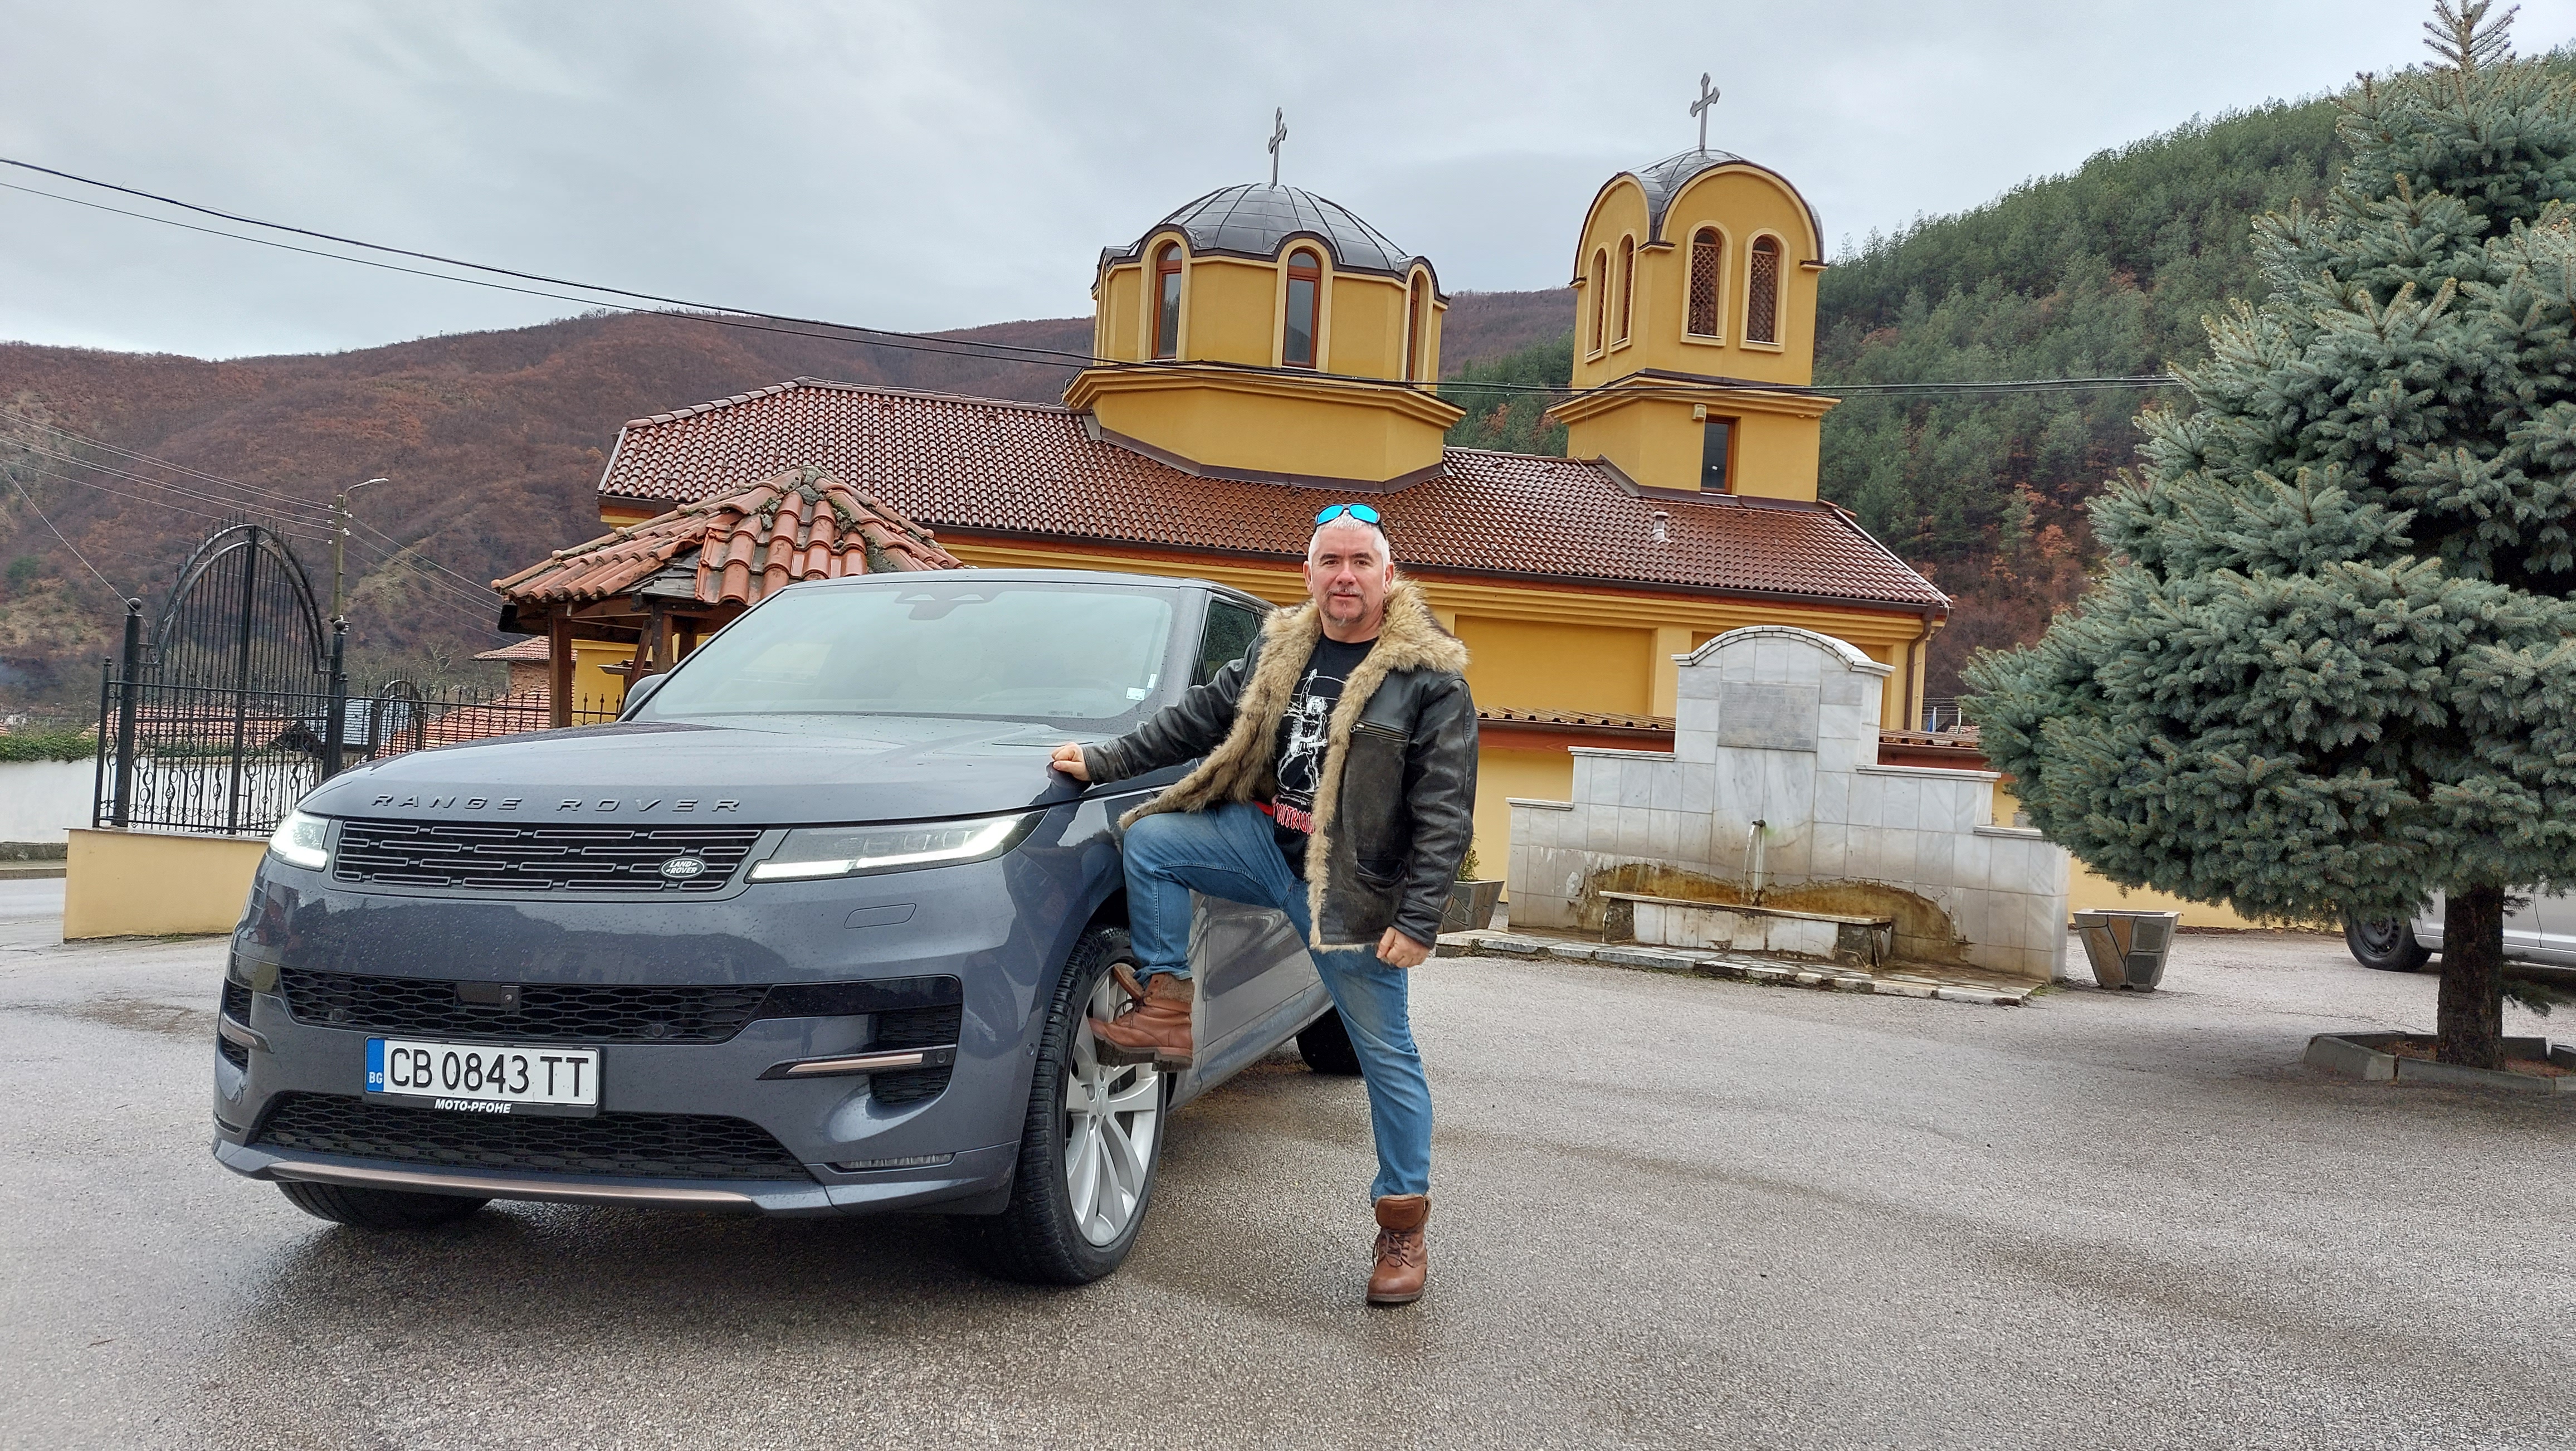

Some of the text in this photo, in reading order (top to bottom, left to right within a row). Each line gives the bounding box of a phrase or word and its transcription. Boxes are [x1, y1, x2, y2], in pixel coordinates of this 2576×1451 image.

[371, 793, 740, 812] RANGE ROVER
[368, 1071, 383, 1084] BG
[390, 1048, 589, 1097] CB 0843 TT
[434, 1098, 511, 1114] MOTO-PFOHE
